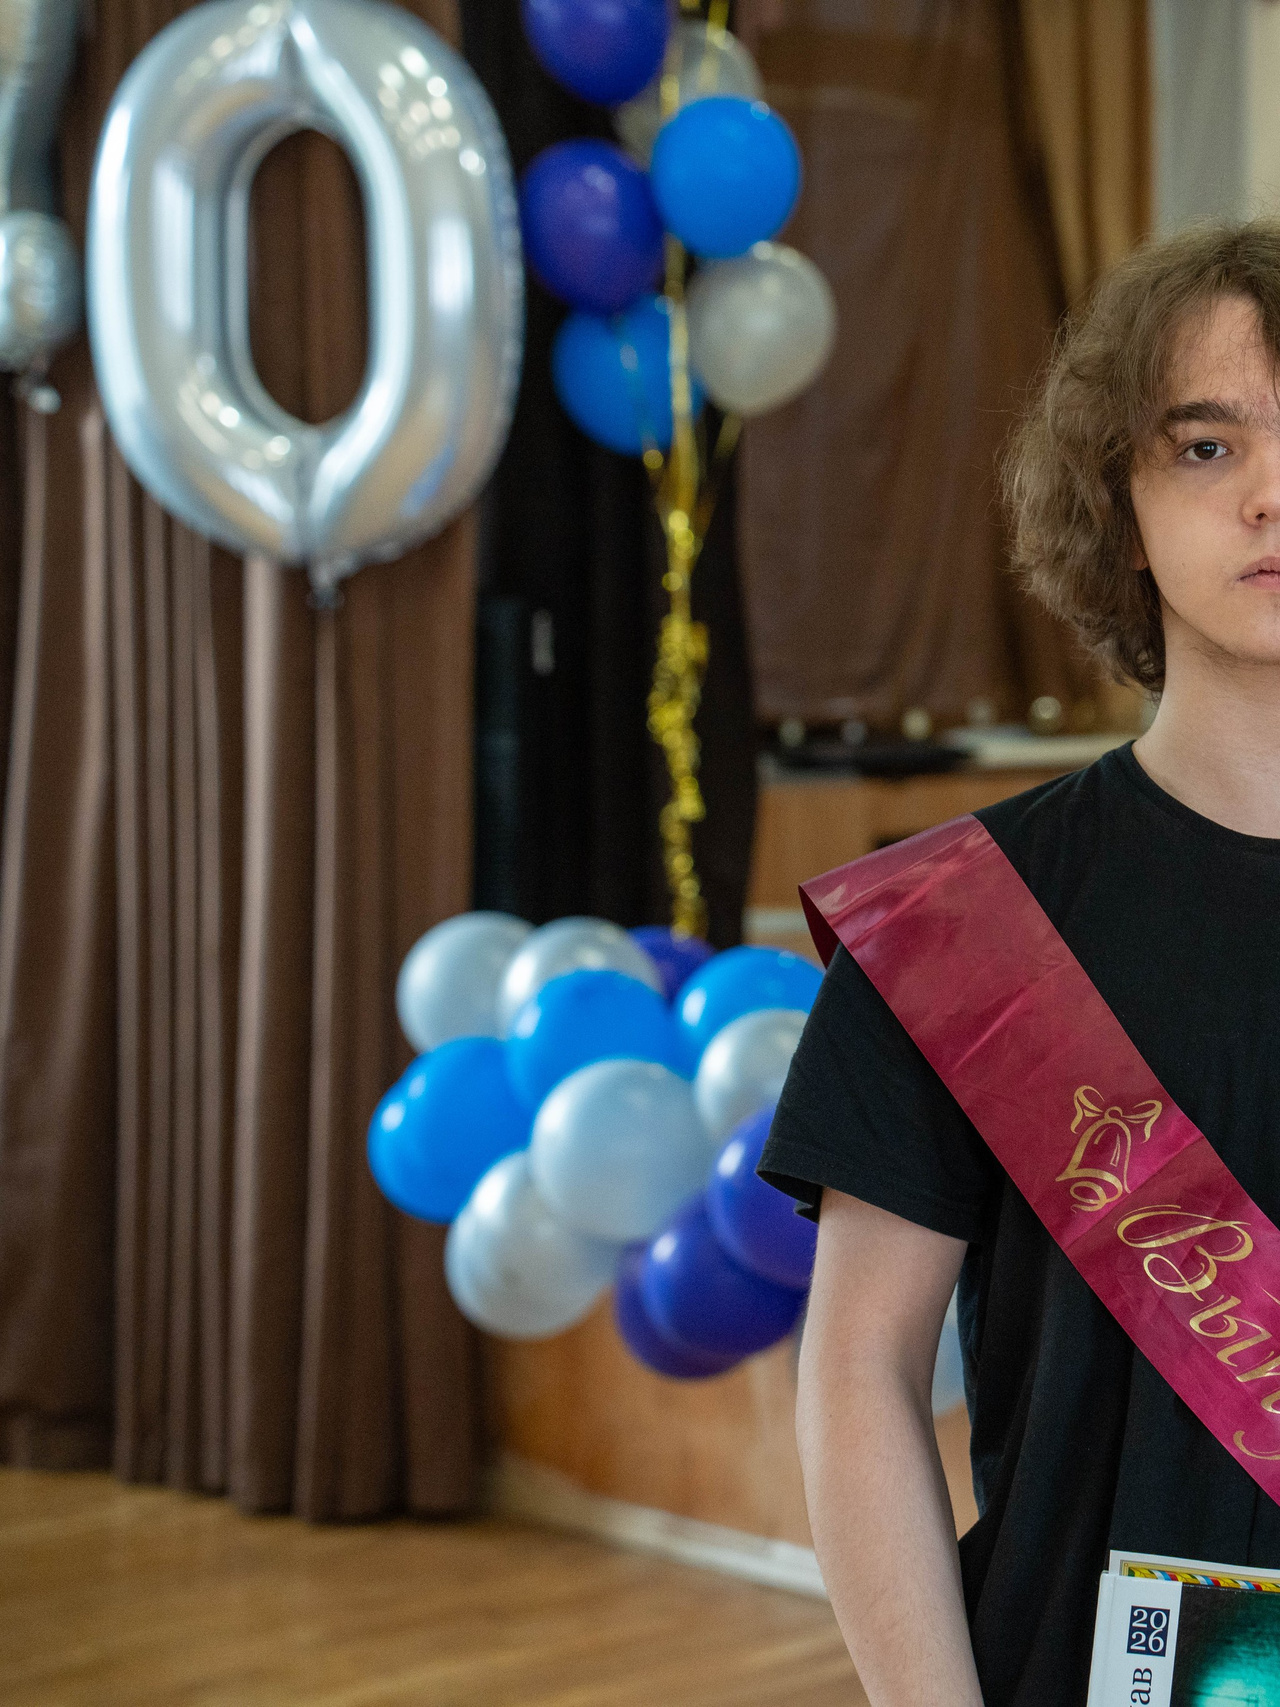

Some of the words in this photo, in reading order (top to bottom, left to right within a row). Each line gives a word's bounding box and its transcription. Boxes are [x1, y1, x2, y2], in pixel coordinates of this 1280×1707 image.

[1131, 1608, 1168, 1630] 20
[1129, 1628, 1165, 1653] 26
[1129, 1667, 1153, 1707] ав
